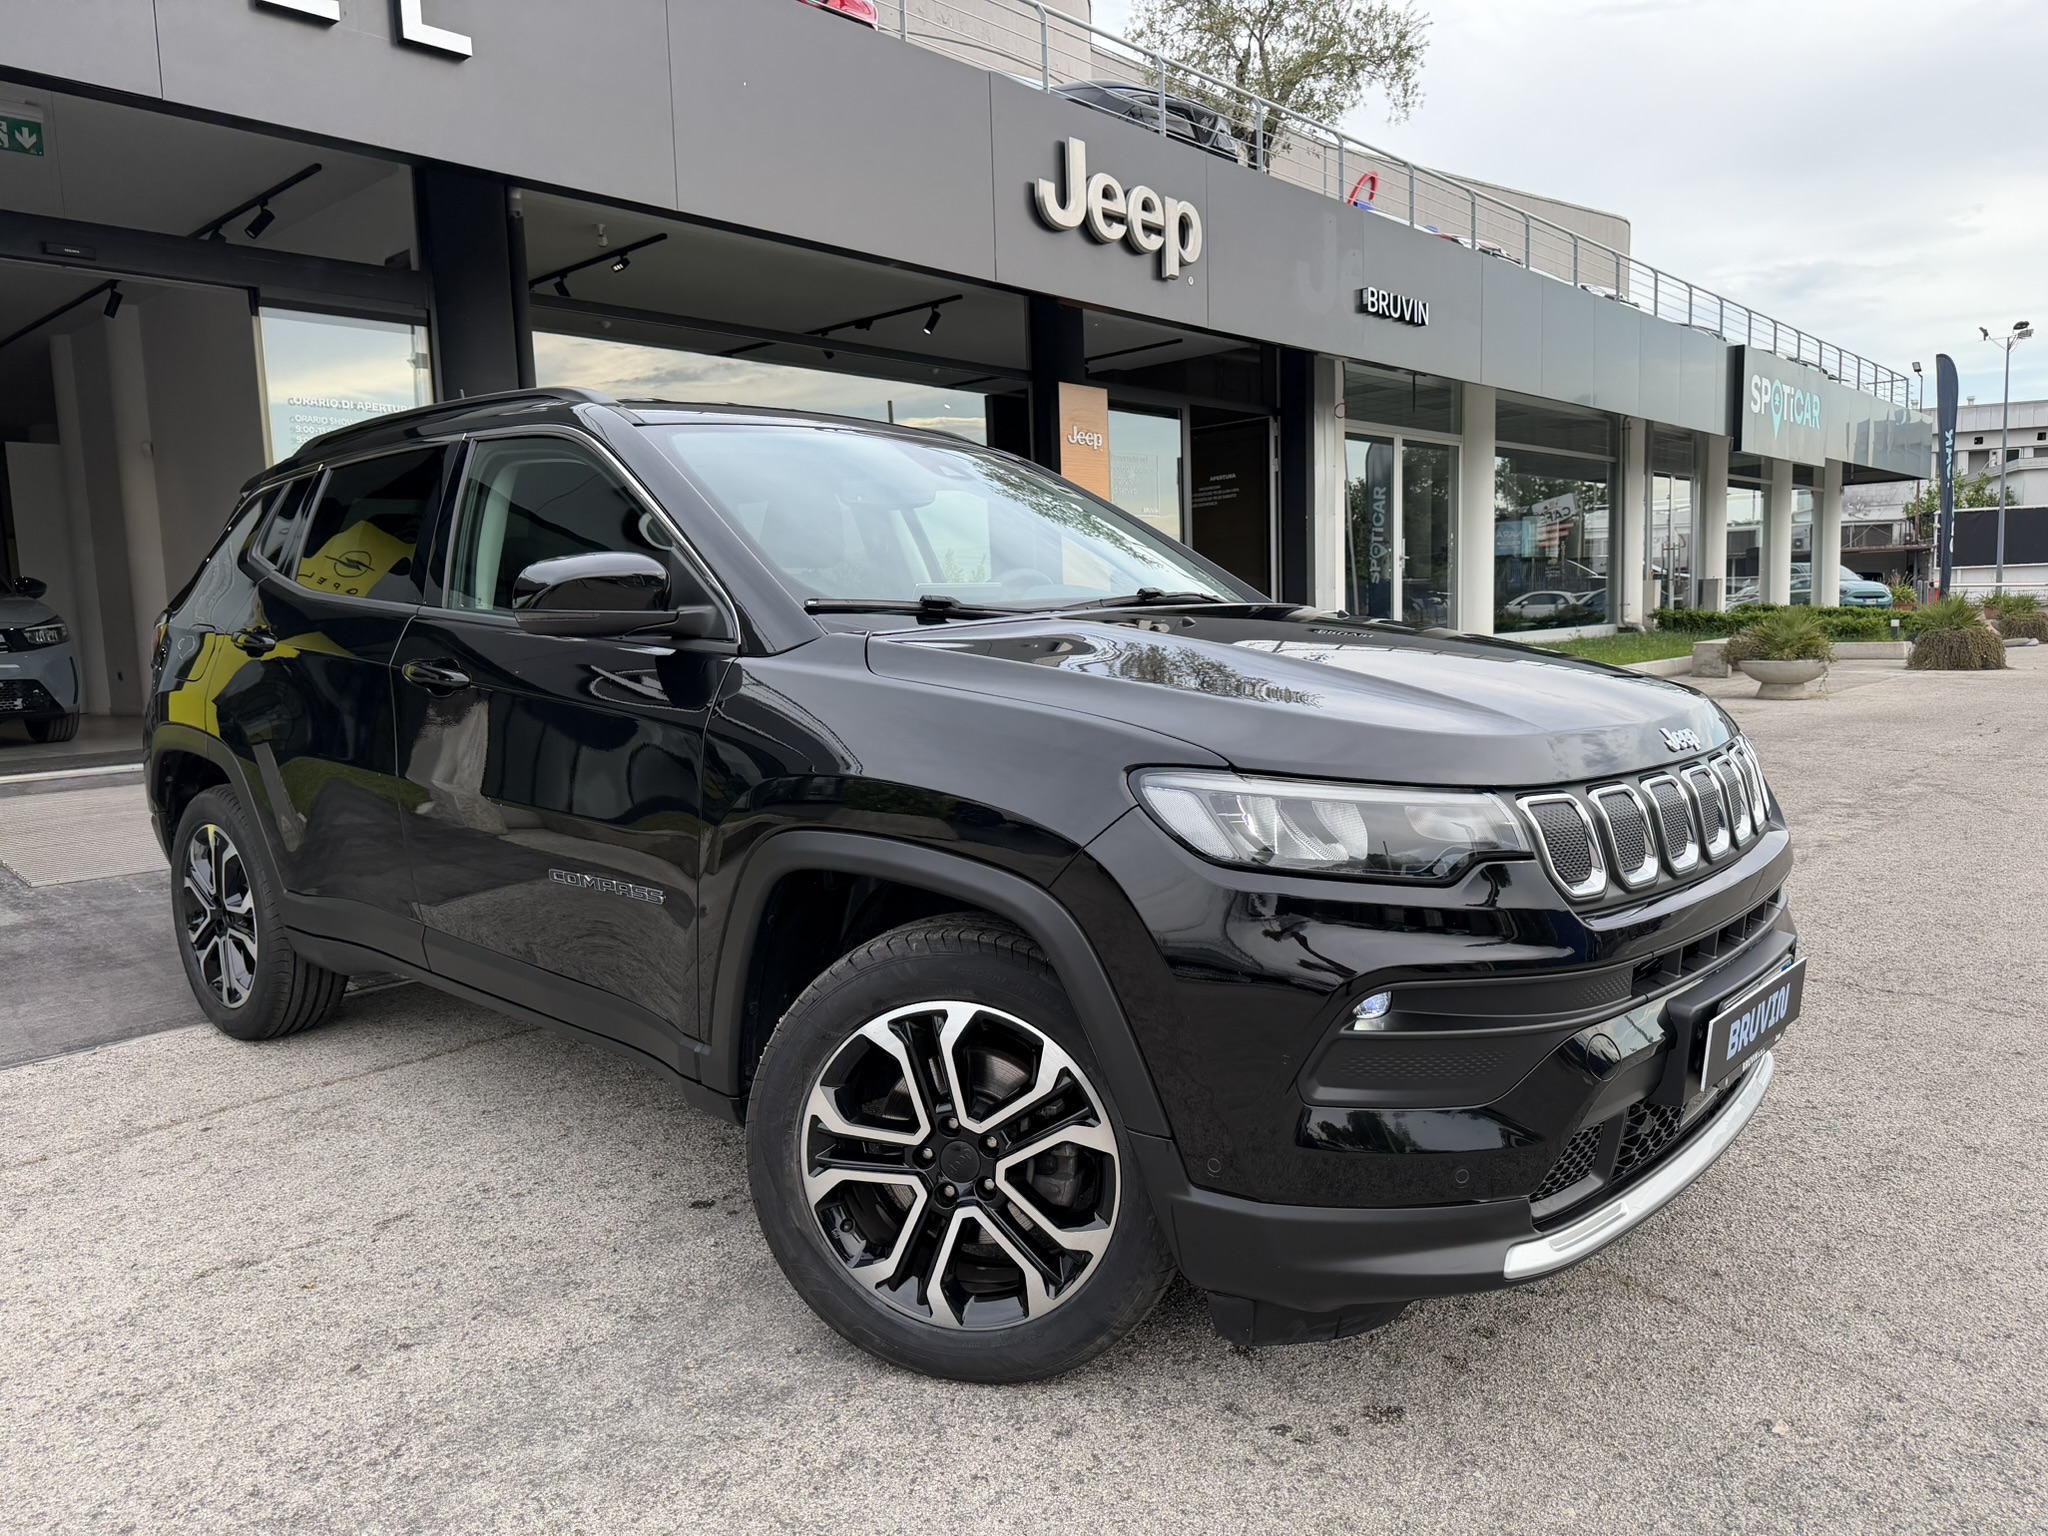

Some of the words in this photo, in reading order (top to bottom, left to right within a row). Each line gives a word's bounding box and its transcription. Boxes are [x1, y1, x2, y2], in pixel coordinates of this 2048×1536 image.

[1035, 136, 1203, 280] Jeep
[1366, 286, 1429, 326] BRUVIN
[293, 397, 339, 408] ORARIO
[341, 400, 354, 410] DI
[295, 415, 328, 425] ORARIO
[1067, 425, 1103, 450] Jeep
[1659, 727, 1702, 752] Jeep
[548, 868, 665, 906] COMPASS
[1726, 982, 1790, 1061] BRUVIN
